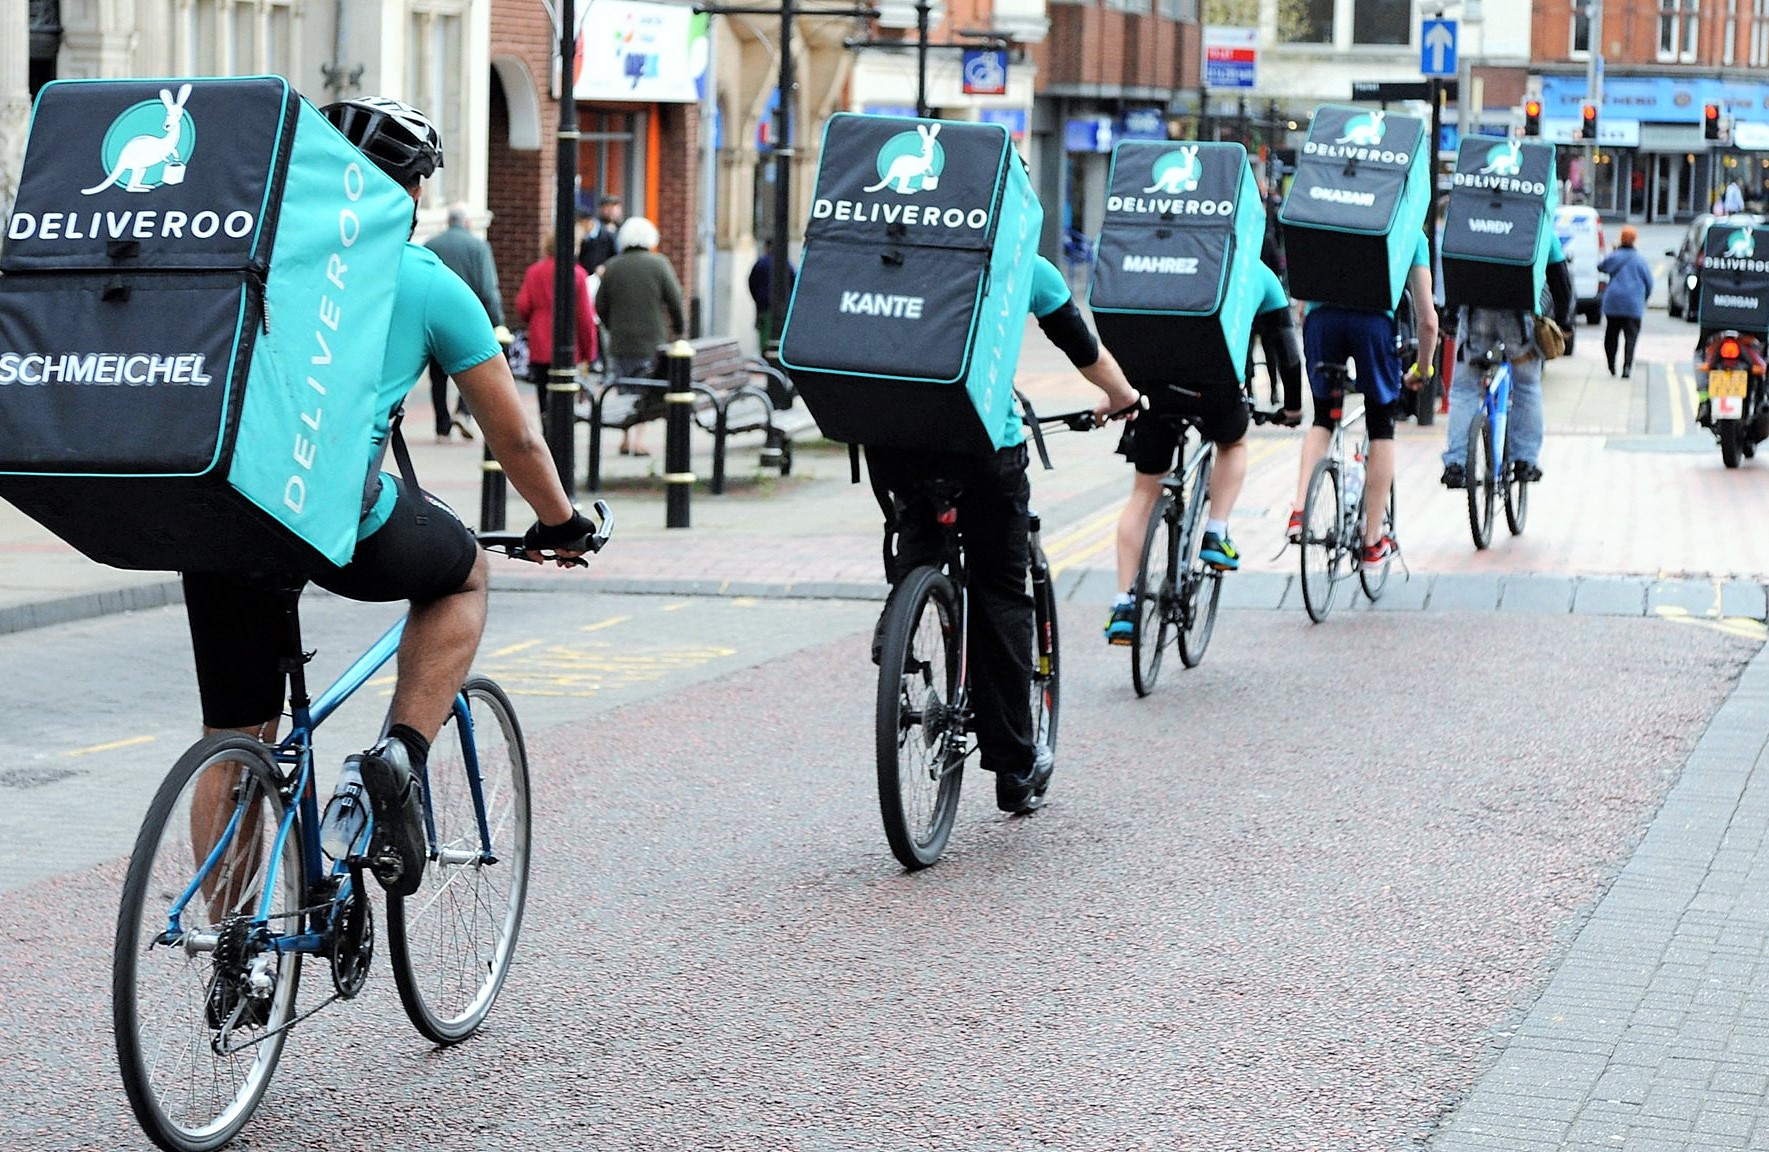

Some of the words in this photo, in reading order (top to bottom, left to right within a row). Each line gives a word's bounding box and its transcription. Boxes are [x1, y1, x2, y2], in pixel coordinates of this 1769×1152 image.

[1303, 141, 1409, 165] DELIVEROO
[1454, 173, 1545, 195] DELIVEROO
[813, 199, 987, 229] DELIVEROO
[1107, 196, 1233, 216] DELIVEROO
[8, 210, 254, 240] DELIVEROO
[1468, 218, 1513, 235] VARDY
[1122, 255, 1199, 274] MAHREZ
[840, 291, 925, 319] KANTE
[1714, 294, 1759, 309] MORGAN
[283, 162, 363, 514] DELIVEROO
[0, 352, 212, 386] SCHMEICHEL
